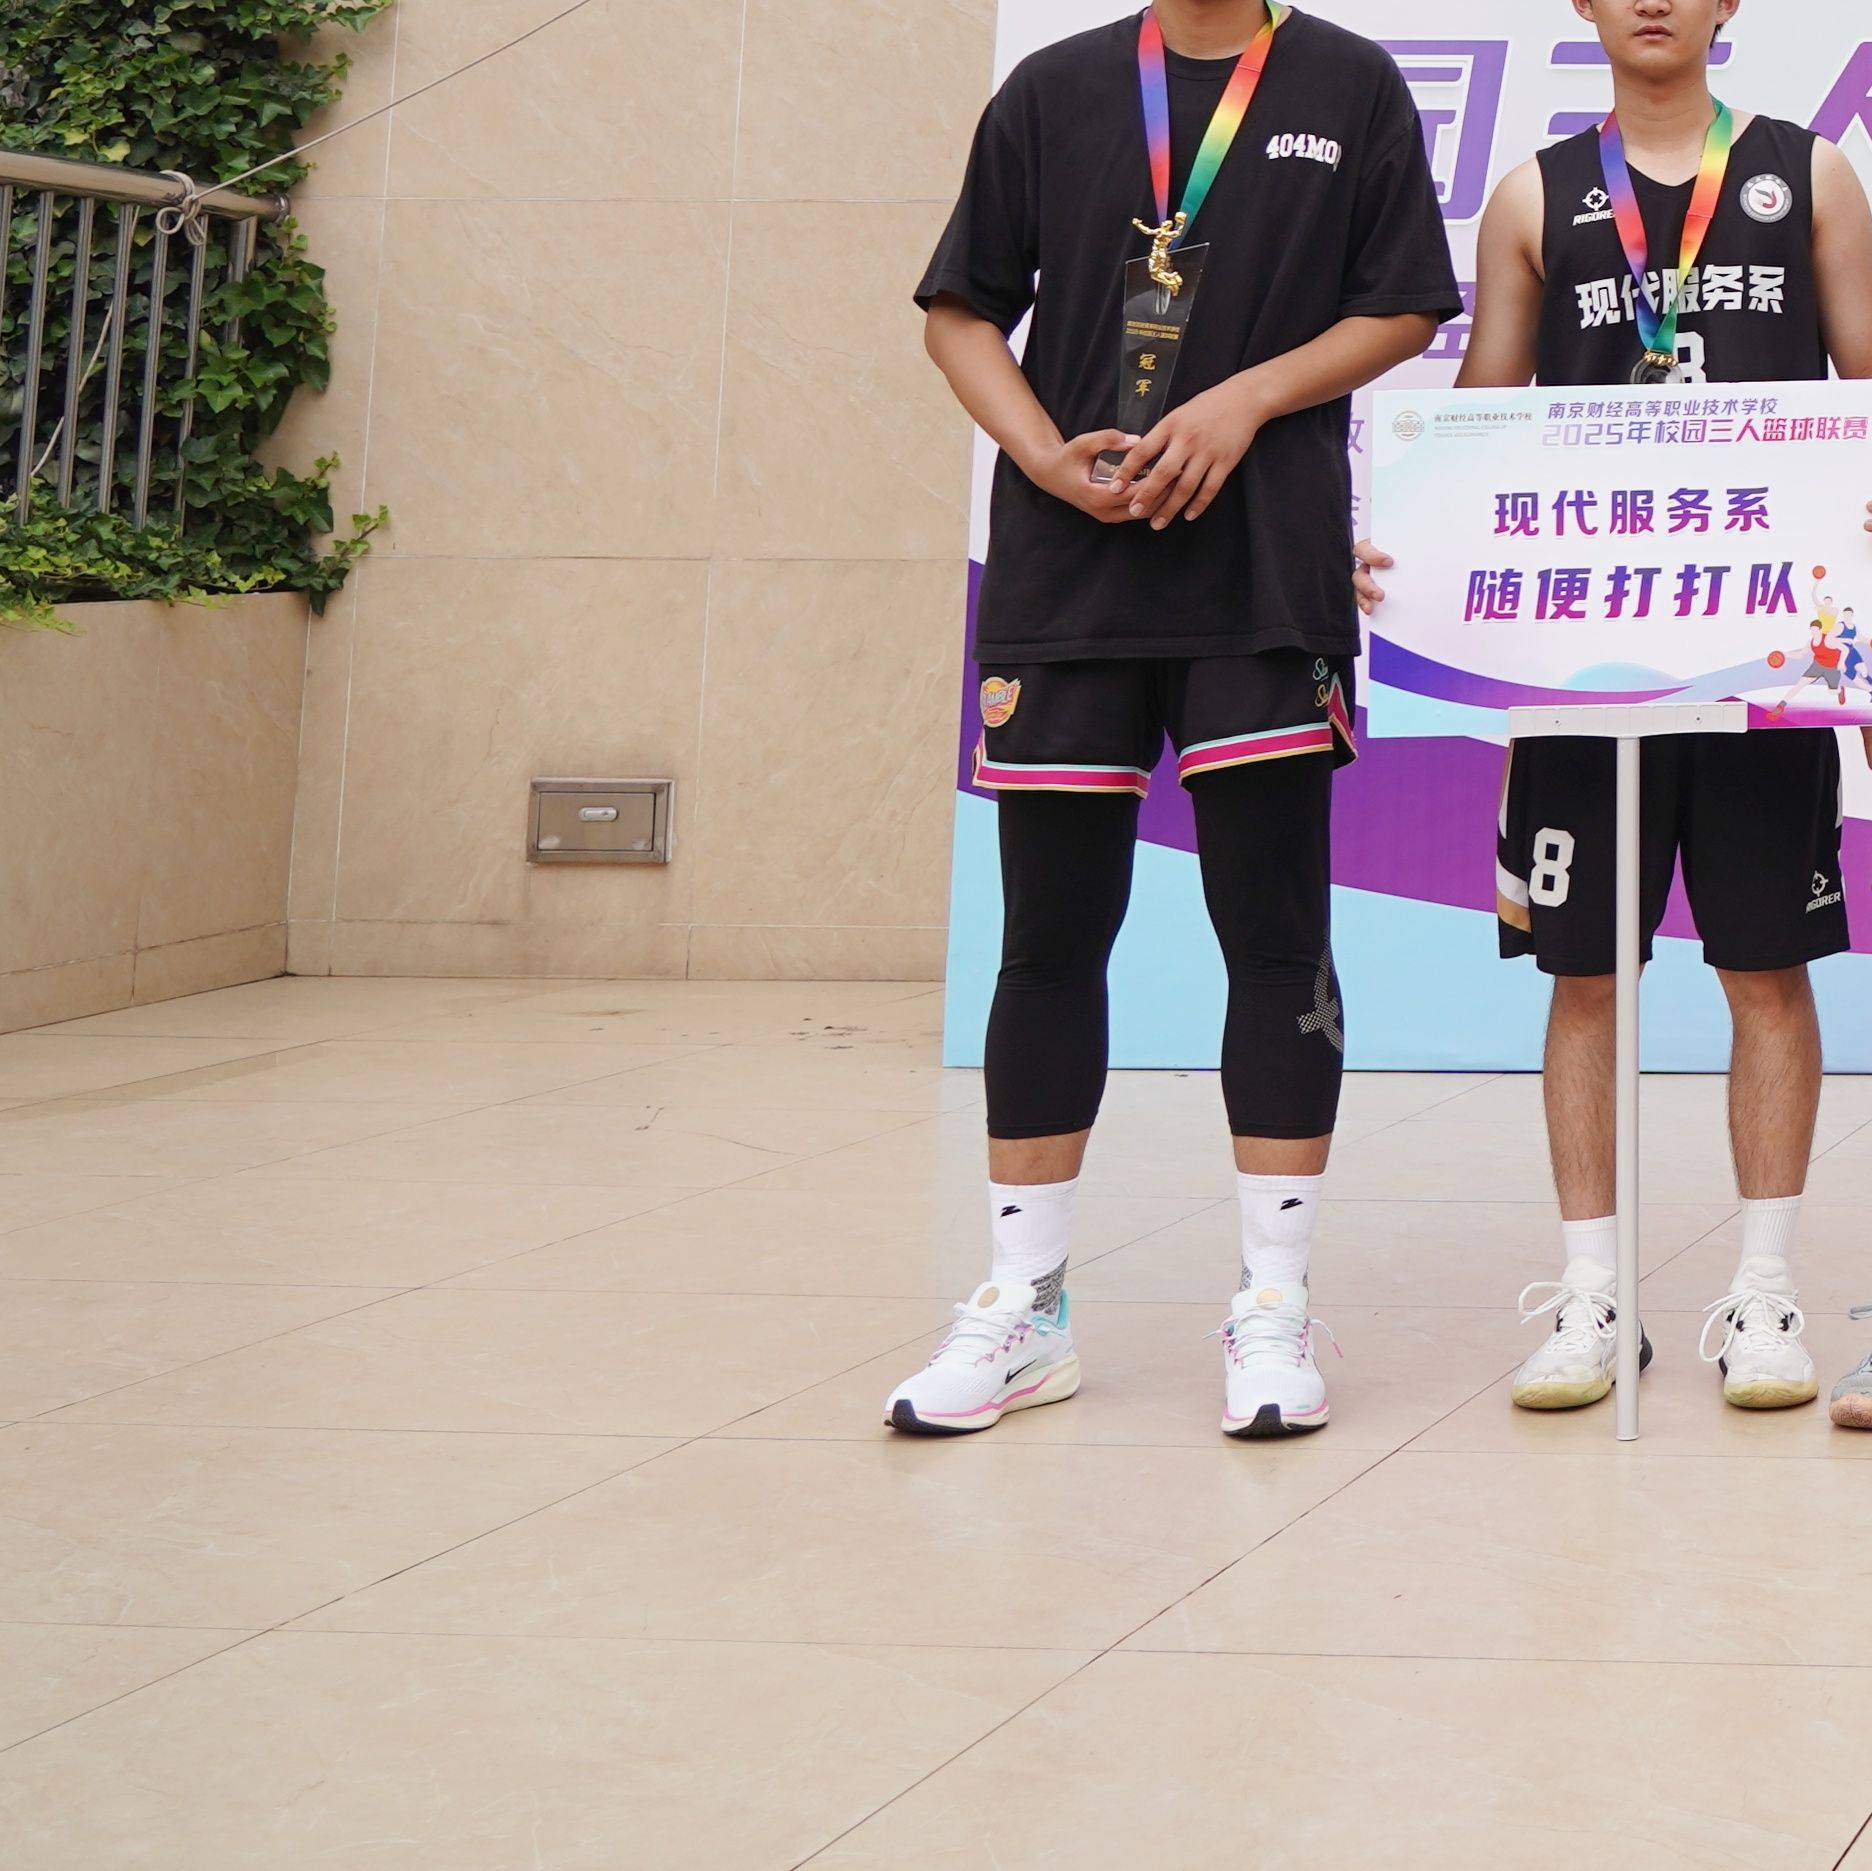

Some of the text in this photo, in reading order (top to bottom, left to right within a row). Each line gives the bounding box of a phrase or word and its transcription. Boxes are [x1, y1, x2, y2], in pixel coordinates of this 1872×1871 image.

[1573, 209, 1616, 226] RIGORE
[1547, 397, 1779, 420] 南京财经高等职业技术学校
[1542, 415, 1869, 447] 2025年校园三人篮球联赛
[1493, 485, 1771, 538] 现代服务系
[1463, 560, 1799, 624] 随便打打队
[1529, 827, 1575, 908] 8
